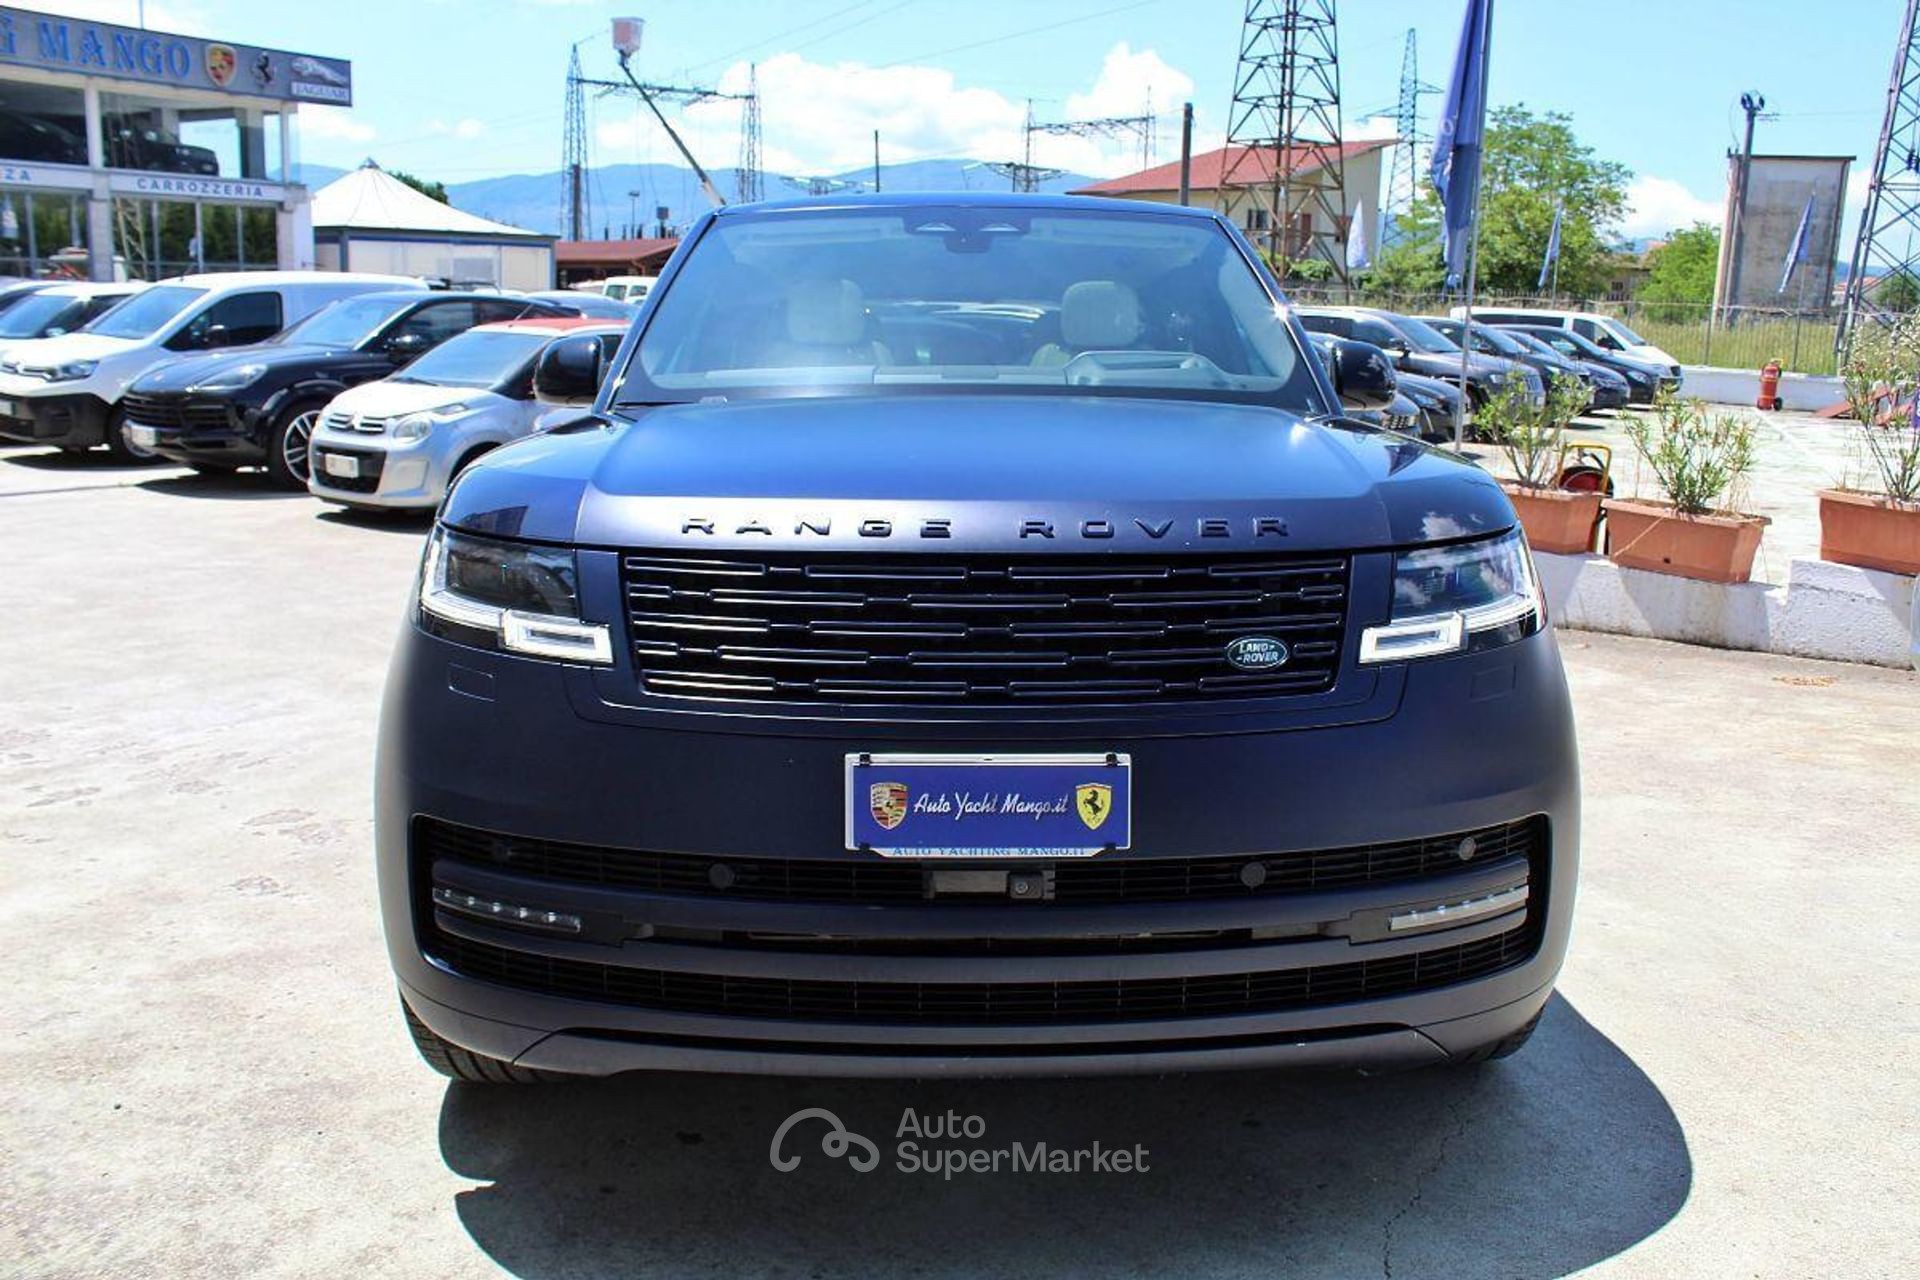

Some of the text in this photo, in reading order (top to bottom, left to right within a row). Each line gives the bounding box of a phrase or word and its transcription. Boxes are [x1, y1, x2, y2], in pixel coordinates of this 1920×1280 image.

[38, 21, 191, 79] MANGO
[295, 83, 349, 100] JAGUAR
[136, 178, 263, 197] CARROZZERIA
[682, 517, 1290, 539] RANGE ROVER
[913, 791, 1068, 820] Auto Yacht Mango.it
[893, 847, 1085, 856] AUTO YACHTING MANGO.IT
